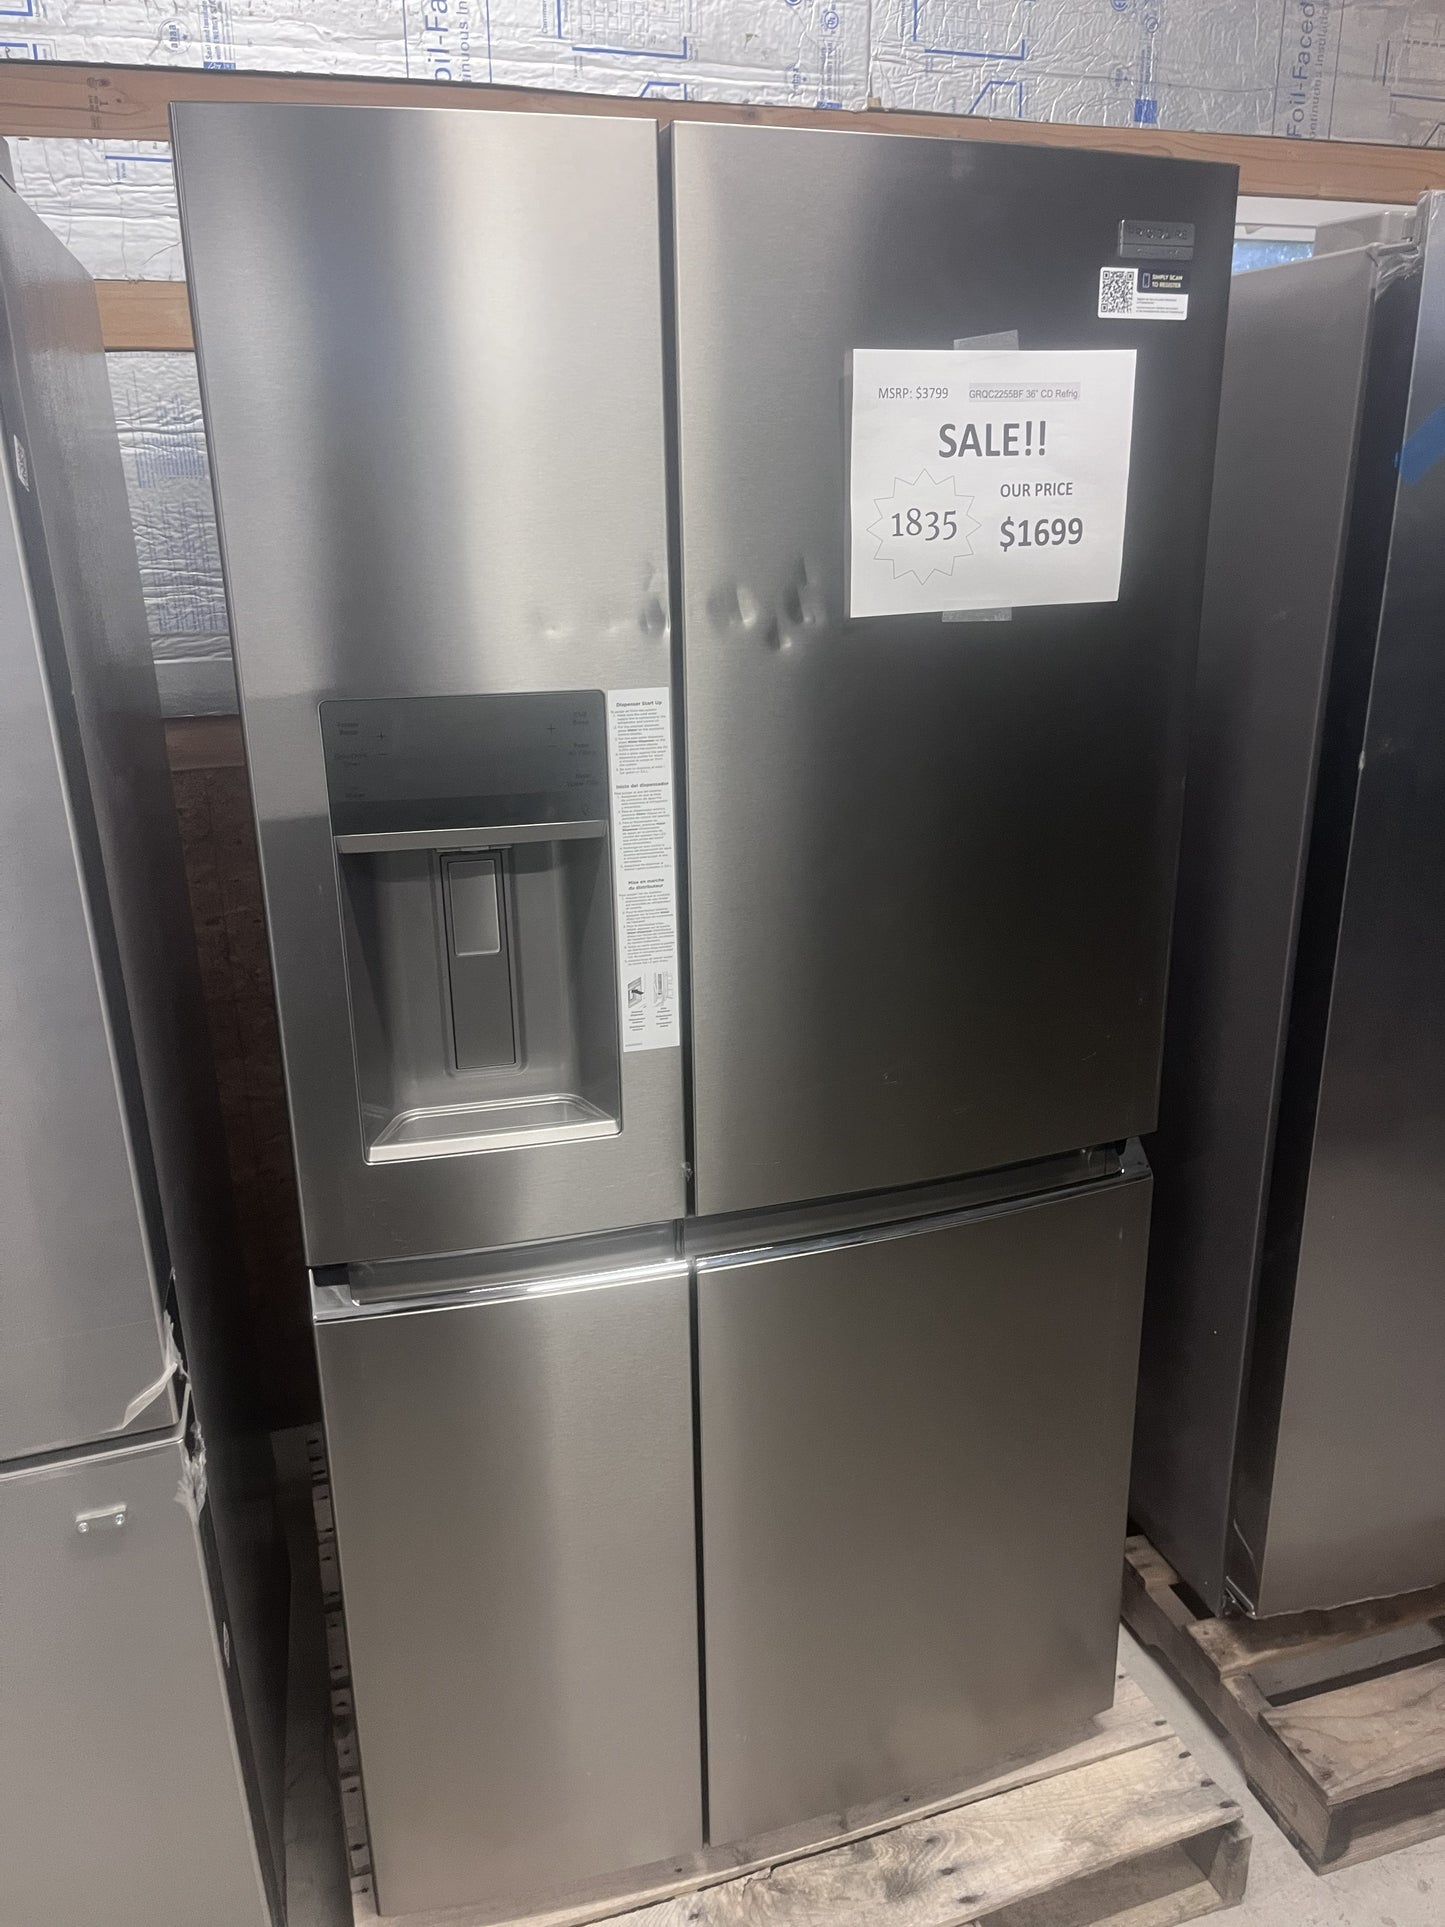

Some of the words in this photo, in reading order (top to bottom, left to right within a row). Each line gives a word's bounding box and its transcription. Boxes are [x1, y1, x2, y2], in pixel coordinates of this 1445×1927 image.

[1286, 1, 1316, 138] Foil-Faced
[878, 387, 913, 399] MSRP:
[915, 386, 949, 400] $3799
[969, 388, 1024, 399] GRQC2255BF
[1026, 388, 1039, 399] 36"
[1040, 388, 1054, 399] CD
[938, 420, 1047, 458] SALE!!
[1000, 482, 1031, 498] OUR
[1034, 481, 1074, 497] PRICE
[891, 507, 958, 542] 1835
[999, 516, 1084, 553] $1699
